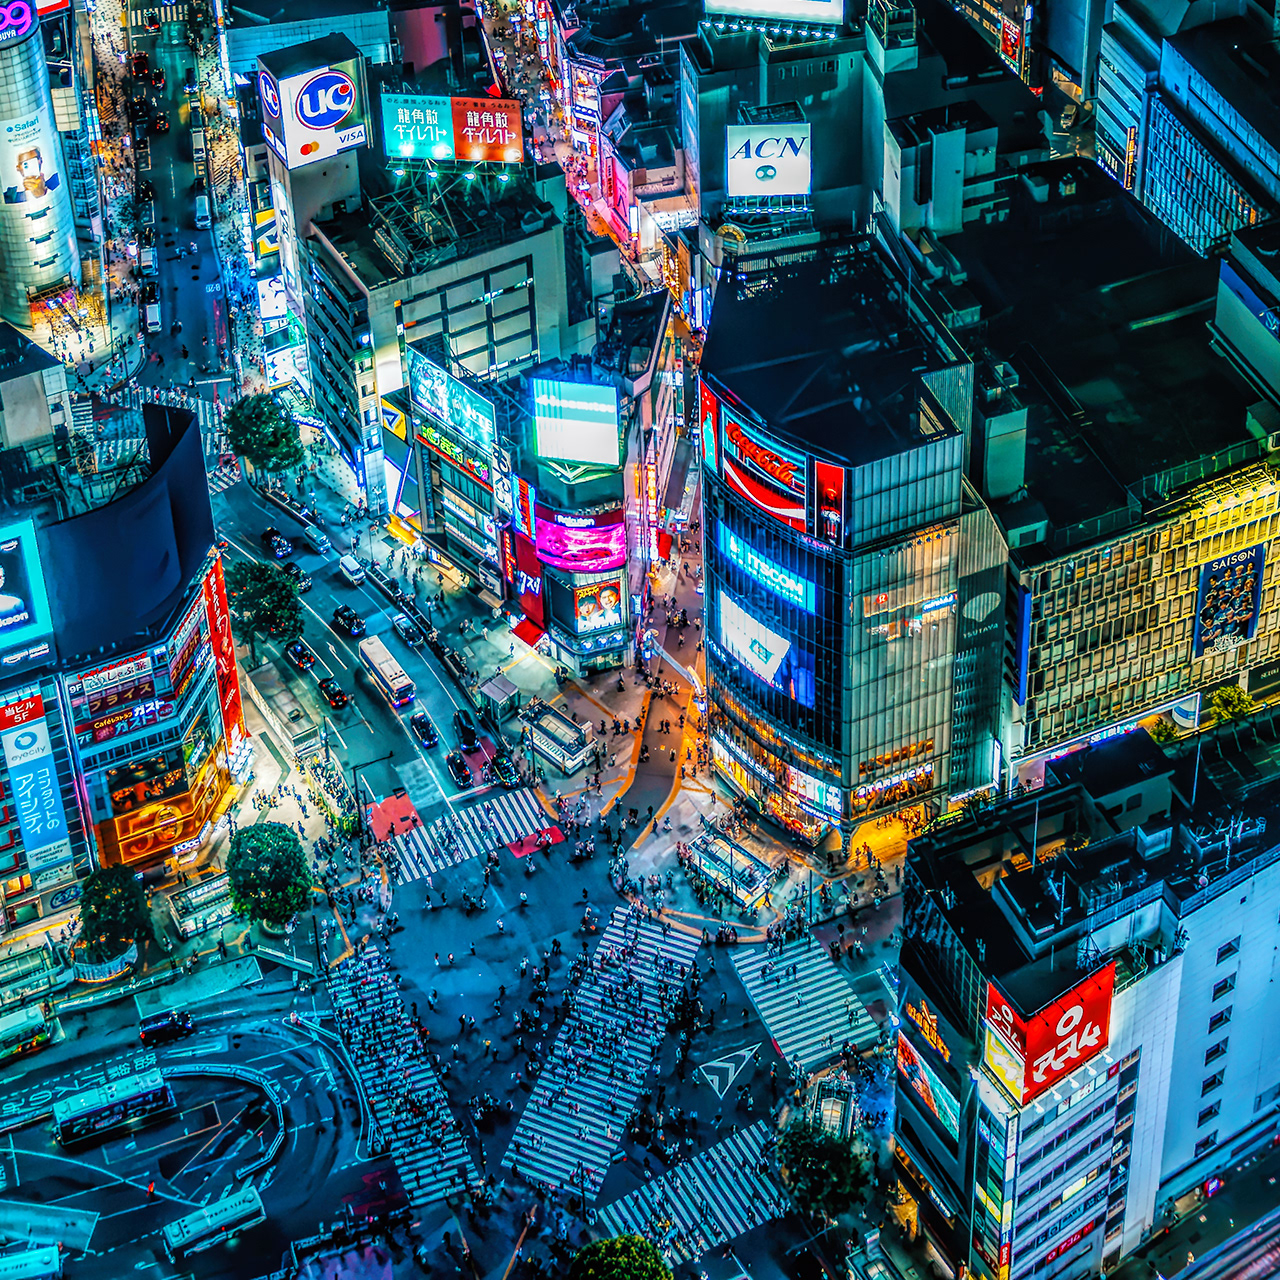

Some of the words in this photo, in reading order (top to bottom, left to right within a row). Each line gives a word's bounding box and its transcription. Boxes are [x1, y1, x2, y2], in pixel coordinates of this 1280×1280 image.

[303, 83, 354, 118] UC
[13, 116, 40, 132] Safari
[397, 108, 439, 125] 龍角散
[465, 110, 509, 127] 龍角散
[339, 130, 365, 144] VISA
[393, 124, 443, 141] ダイレクト
[461, 126, 512, 144] ダイレクト
[730, 135, 809, 161] ACN
[725, 422, 799, 488] Coca-Cola
[1210, 548, 1257, 572] SAISON
[962, 623, 1000, 638] TSUTAYA
[69, 683, 82, 694] 9F
[4, 701, 36, 718] 当ビル
[14, 711, 30, 724] 5F
[77, 733, 94, 745] 7F
[11, 744, 47, 762] eyecity
[857, 762, 934, 799] STARBUCKS
[15, 773, 44, 835] アイシティ
[37, 767, 60, 830] コンタクトの
[1033, 1021, 1101, 1083] アコム
